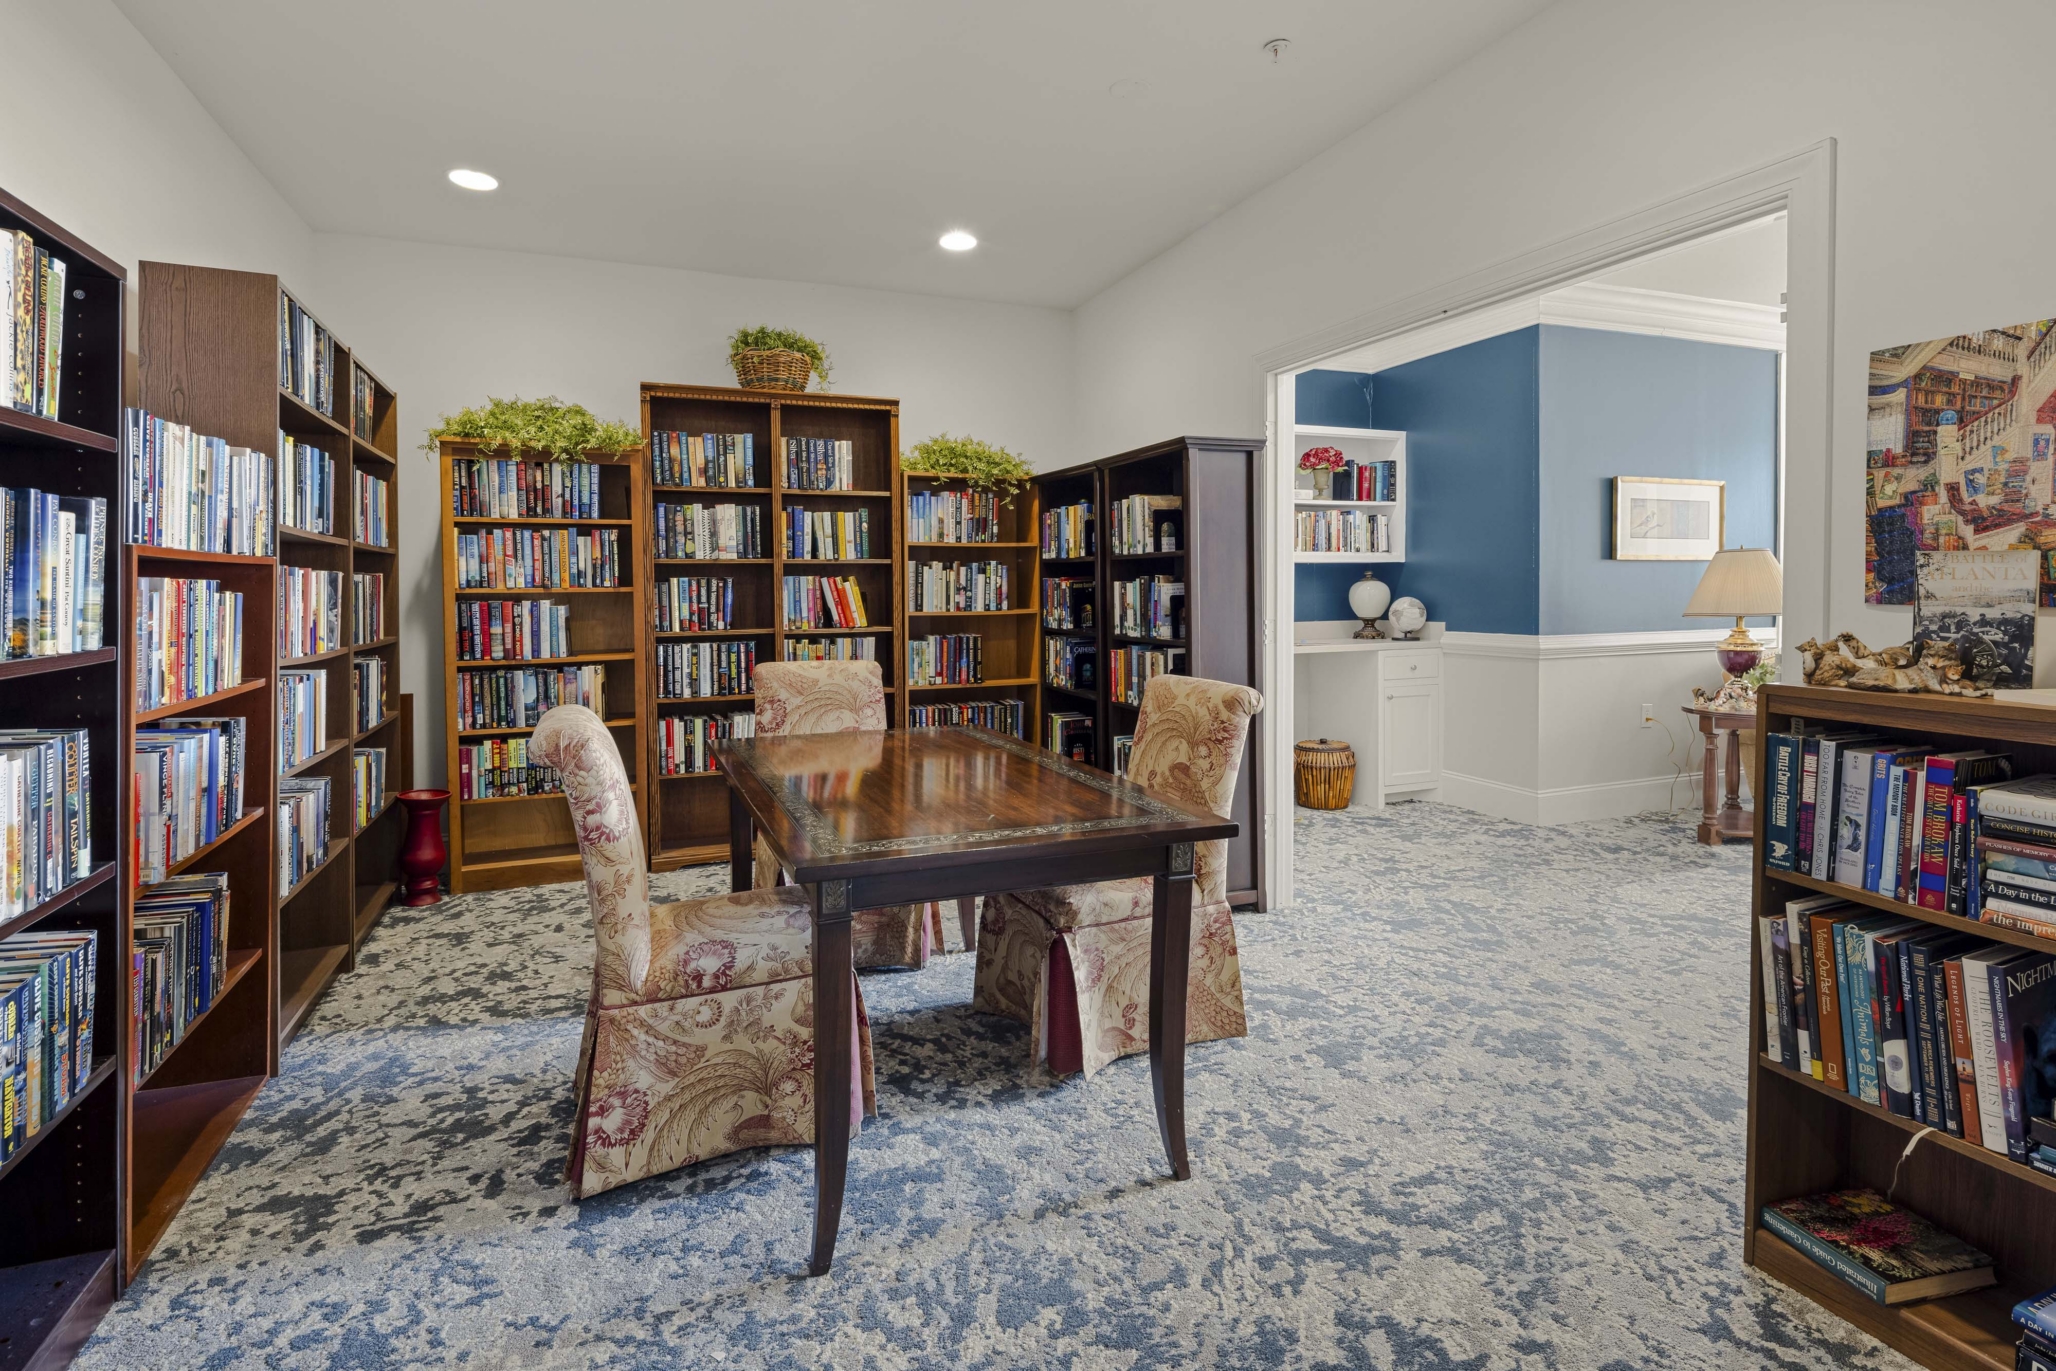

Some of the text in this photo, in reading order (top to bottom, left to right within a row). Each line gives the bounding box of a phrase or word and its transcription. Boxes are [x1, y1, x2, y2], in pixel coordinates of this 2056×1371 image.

[40, 256, 48, 277] JACKIE
[40, 277, 48, 304] COLLINS
[6, 312, 14, 352] jackie
[38, 304, 46, 353] HOLLYWOOD
[790, 441, 798, 459] Silva
[64, 532, 72, 556] Great
[91, 544, 100, 582] CONROY
[1950, 554, 2010, 564] BATTLE
[2015, 553, 2027, 564] of
[64, 558, 72, 588] Santini
[1925, 566, 2029, 580] ATLANTA
[1952, 583, 1973, 593] and
[62, 602, 70, 628] Conroy
[46, 748, 54, 793] RECKONING
[1802, 754, 1817, 804] RUSH LIMBAUGH
[1818, 744, 1830, 820] TOO FAR FROM HOME
[1876, 758, 1887, 779] GRITS
[1776, 746, 1791, 828] BATTLE CRY OF FREEDOM
[1892, 784, 1900, 804] MEMORY
[1890, 804, 1898, 817] BOOK
[1955, 800, 1963, 822] Katharine
[1985, 802, 2028, 818] CODE
[1898, 821, 1906, 854] GENERATION
[1904, 823, 1912, 849] BROKAW
[1923, 785, 1936, 863] THE GREATEST GENERATION
[1930, 786, 1948, 866] TOM BROKAW
[1952, 823, 1962, 844] Hepburn
[1990, 821, 2030, 834] CONCISE
[70, 814, 78, 869] TAILSPIN
[1816, 833, 1825, 854] CHRIS
[1985, 842, 2012, 851] FLASHES
[2022, 848, 2050, 858] MEMORY
[1896, 855, 1904, 876] SPEAKS
[1987, 884, 1996, 892] A
[1998, 885, 2017, 898] Day
[2019, 889, 2029, 900] in
[2031, 893, 2048, 904] the
[1993, 912, 2013, 926] the
[1816, 928, 1832, 994] Visiting Our Past
[1900, 956, 1910, 1002] National Parks
[1916, 976, 1927, 1022] ONE NATION
[1934, 973, 1945, 1022] What Life Was Like
[1950, 970, 1964, 1044] LEGENDS OF LIGHT
[1970, 987, 1980, 1023] GEOFFREY
[1992, 976, 2003, 1012] NIGHTMARES
[34, 978, 42, 1062] CLIVE CUSSLER
[1853, 1000, 1873, 1045] Animals
[1997, 1012, 2004, 1020] IN
[1978, 988, 2002, 1106] THE ROOSEVELTS
[2000, 1032, 2008, 1044] SKY
[60, 1054, 68, 1099] STORM
[1928, 1060, 1936, 1088] REMEMBERS
[1978, 1064, 1986, 1080] KEN
[2002, 1060, 2012, 1078] Stephen
[1980, 1081, 1988, 1104] BURNS
[4, 1076, 14, 1139] NAVIGATOR
[1764, 1212, 1878, 1294] Illustrated Guide to Gardening
[2020, 1317, 2054, 1339] A DAY IN
